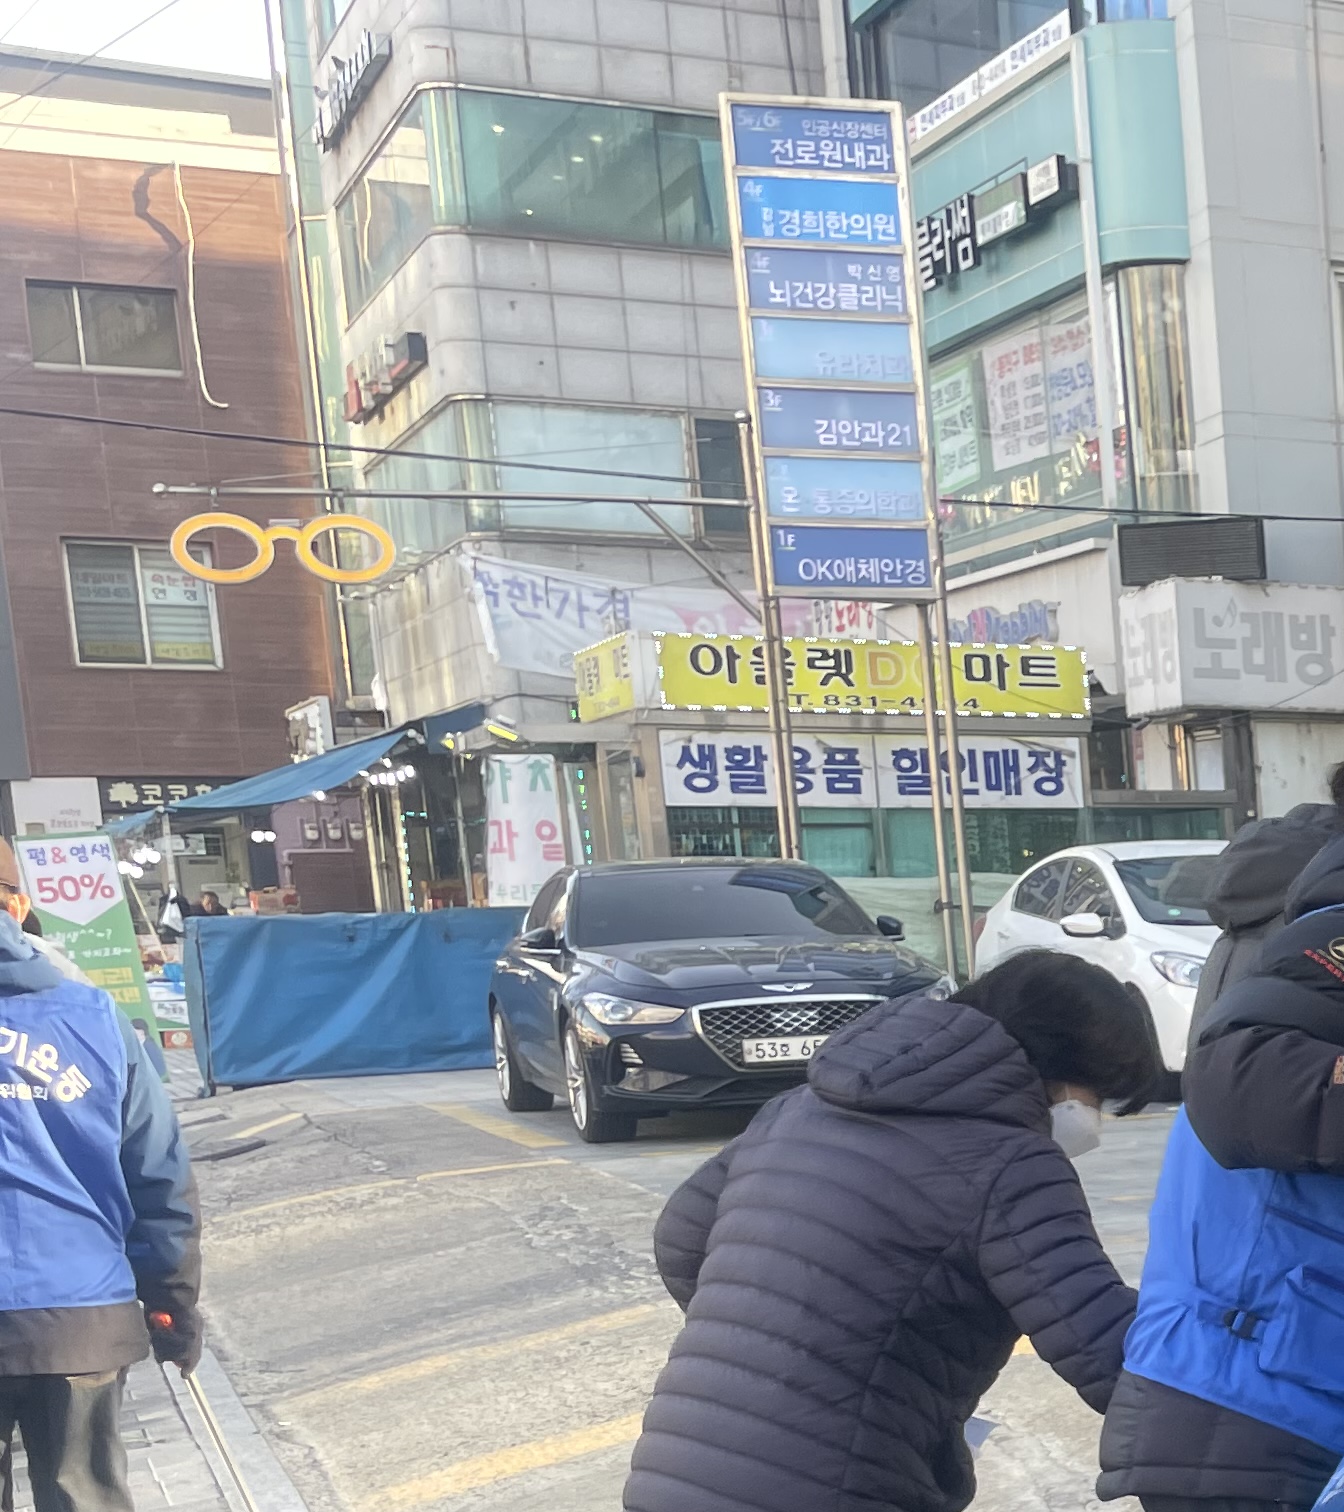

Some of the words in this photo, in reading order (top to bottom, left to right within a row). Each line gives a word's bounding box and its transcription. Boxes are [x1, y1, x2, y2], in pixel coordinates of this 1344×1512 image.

[802, 119, 888, 140] 인공신장센터
[771, 138, 890, 170] 전로원내과
[779, 209, 896, 241] 경희한의원
[769, 280, 903, 312] 뇌건강클리닉
[763, 389, 783, 407] 3F
[815, 419, 912, 447] 김안과21
[777, 530, 796, 546] 1F
[798, 557, 927, 584] OK애체안경
[1193, 607, 1336, 686] 노래방
[489, 819, 565, 862] 과일
[37, 873, 115, 904] 50%
